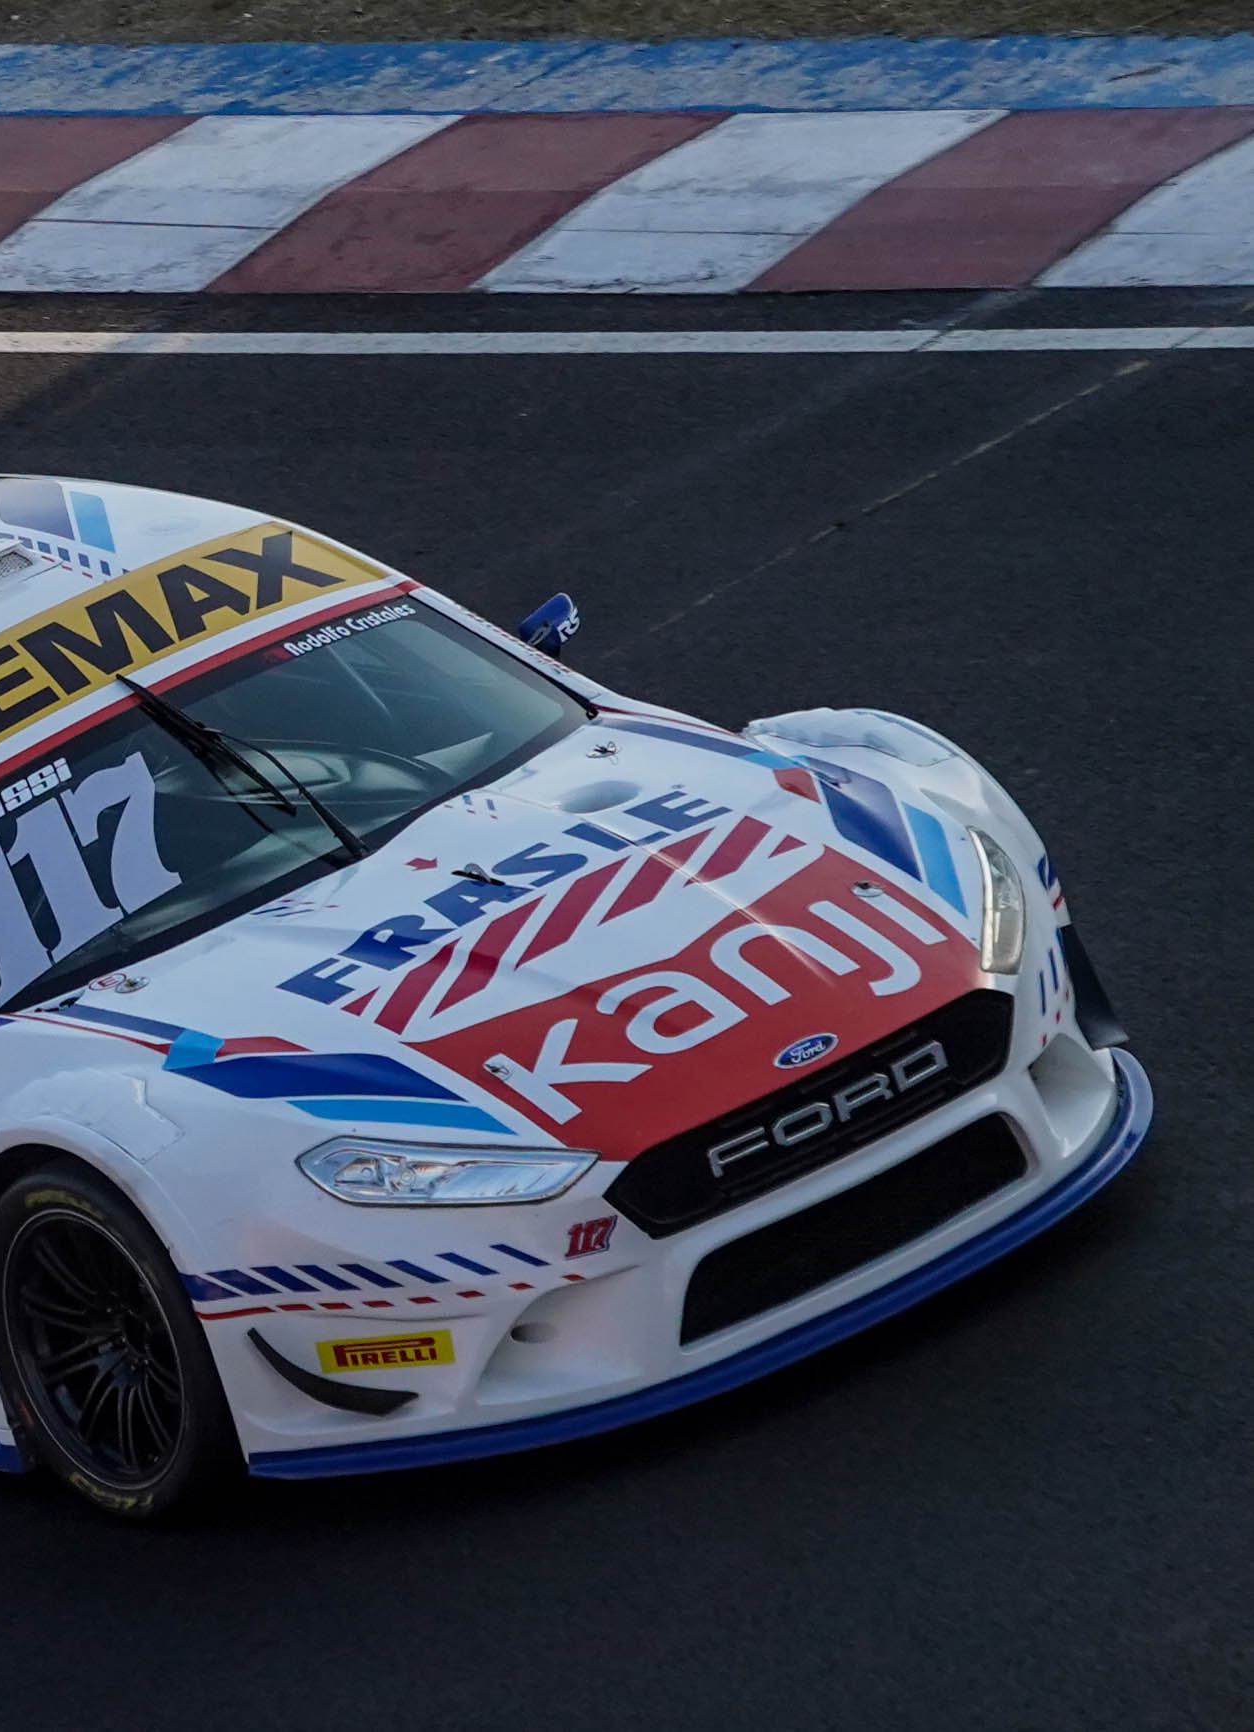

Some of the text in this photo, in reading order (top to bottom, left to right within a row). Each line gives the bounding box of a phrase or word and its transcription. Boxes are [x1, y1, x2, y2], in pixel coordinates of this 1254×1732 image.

[283, 603, 416, 657] Rodolfo Cristales
[276, 790, 733, 1005] FRASLE
[489, 884, 948, 1125] kanji
[707, 1040, 949, 1179] FORD
[565, 1214, 618, 1260] 117
[332, 1336, 439, 1368] PIRELLI
